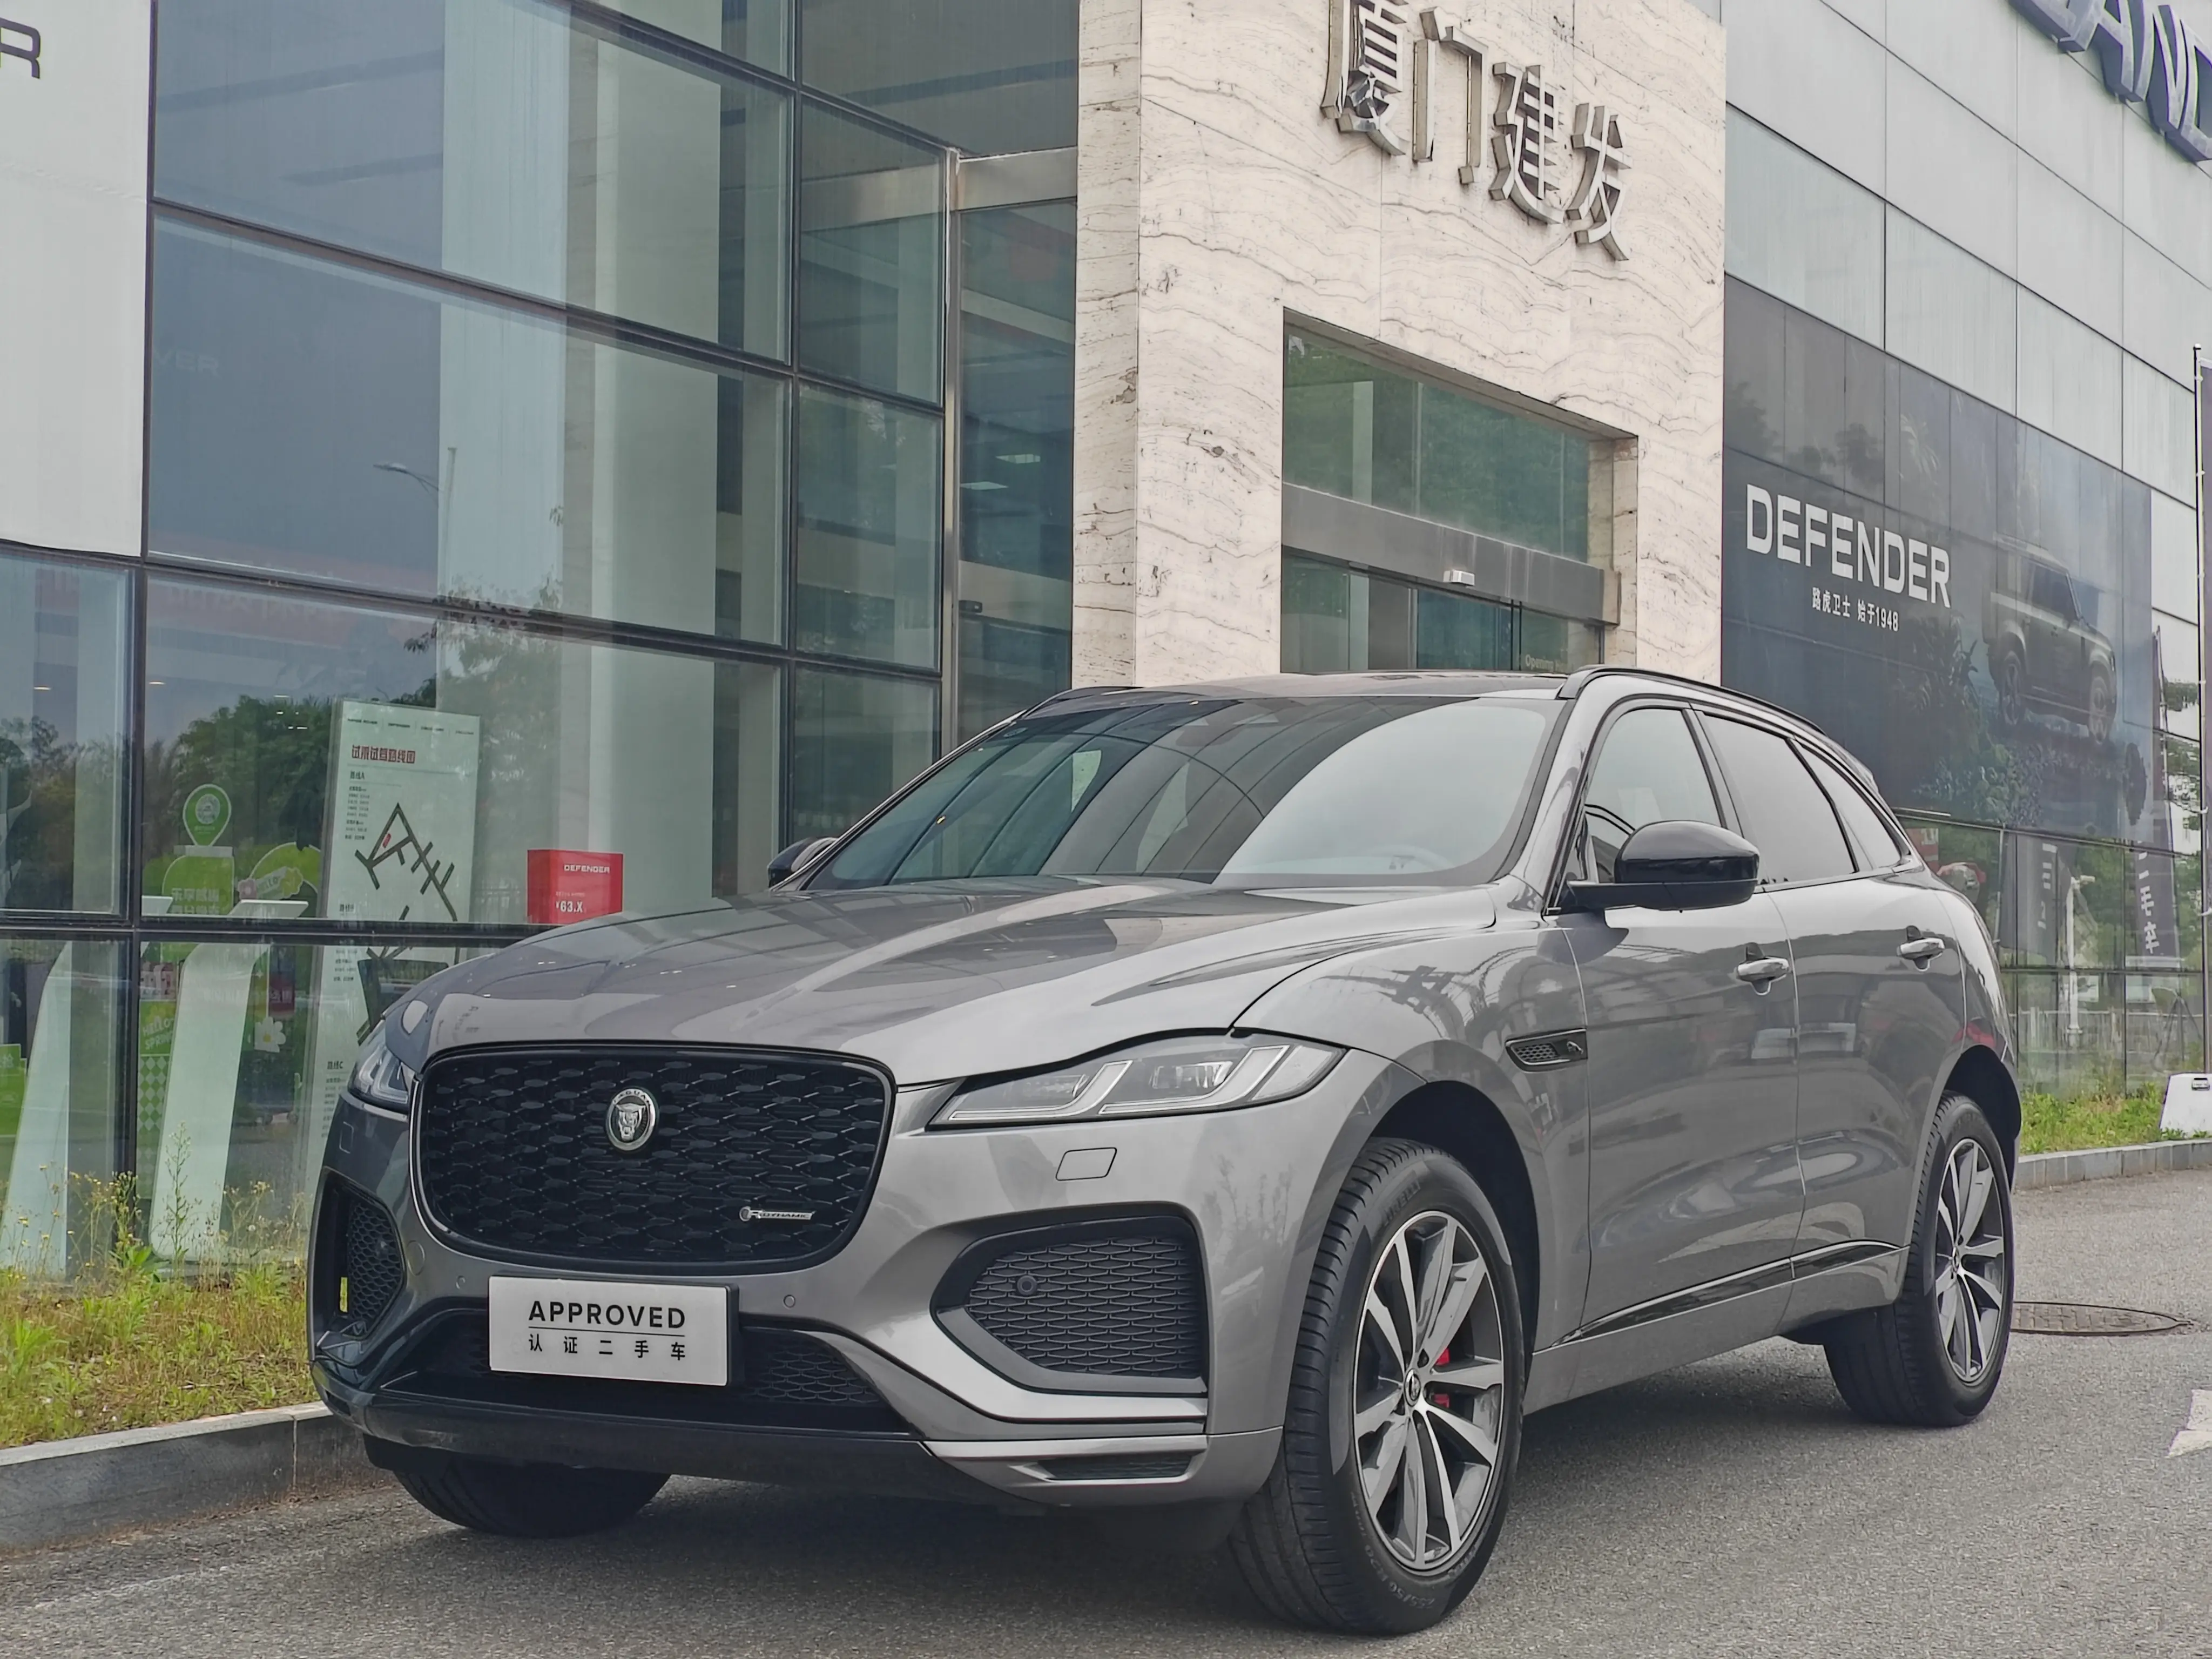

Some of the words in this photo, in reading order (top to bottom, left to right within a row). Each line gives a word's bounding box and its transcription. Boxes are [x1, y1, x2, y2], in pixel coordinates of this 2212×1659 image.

[1320, 0, 1633, 261] 厦门建发
[1746, 483, 1951, 609] DEFENDER
[1812, 586, 1851, 618] 路虎卫士
[1857, 598, 1899, 632] 始于1948
[563, 864, 610, 874] DEFENDER
[529, 1300, 685, 1328] APPROVED
[529, 1333, 685, 1361] 认证二手车
